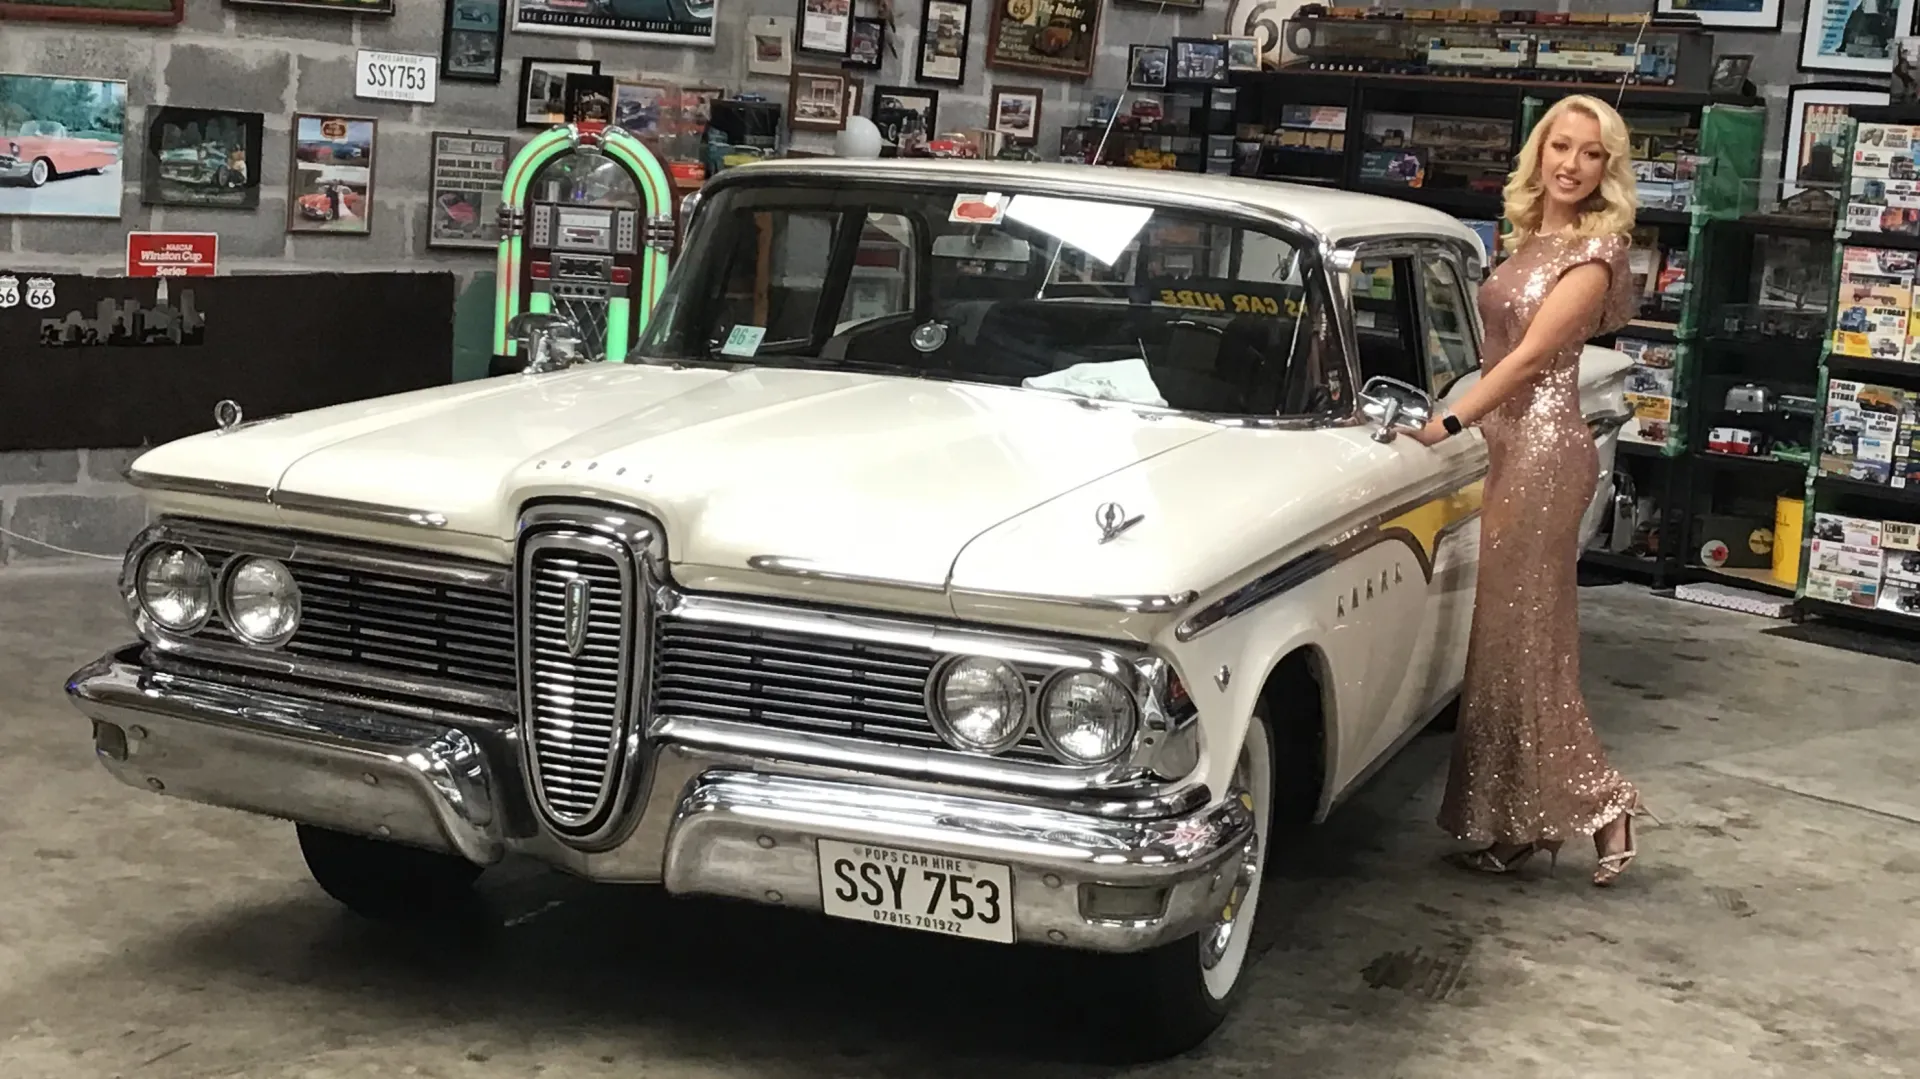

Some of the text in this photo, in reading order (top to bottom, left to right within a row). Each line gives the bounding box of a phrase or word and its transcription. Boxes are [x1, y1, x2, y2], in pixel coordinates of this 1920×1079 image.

[1013, 4, 1027, 15] 66
[367, 62, 426, 90] SSY753
[166, 243, 194, 252] NASCAR
[141, 251, 203, 263] Winston Cup
[156, 266, 188, 276] Series
[31, 289, 52, 305] 66
[865, 848, 963, 873] POPS CAR HIRE
[834, 858, 1001, 924] SSY 753
[873, 909, 963, 934] 07815 701922
